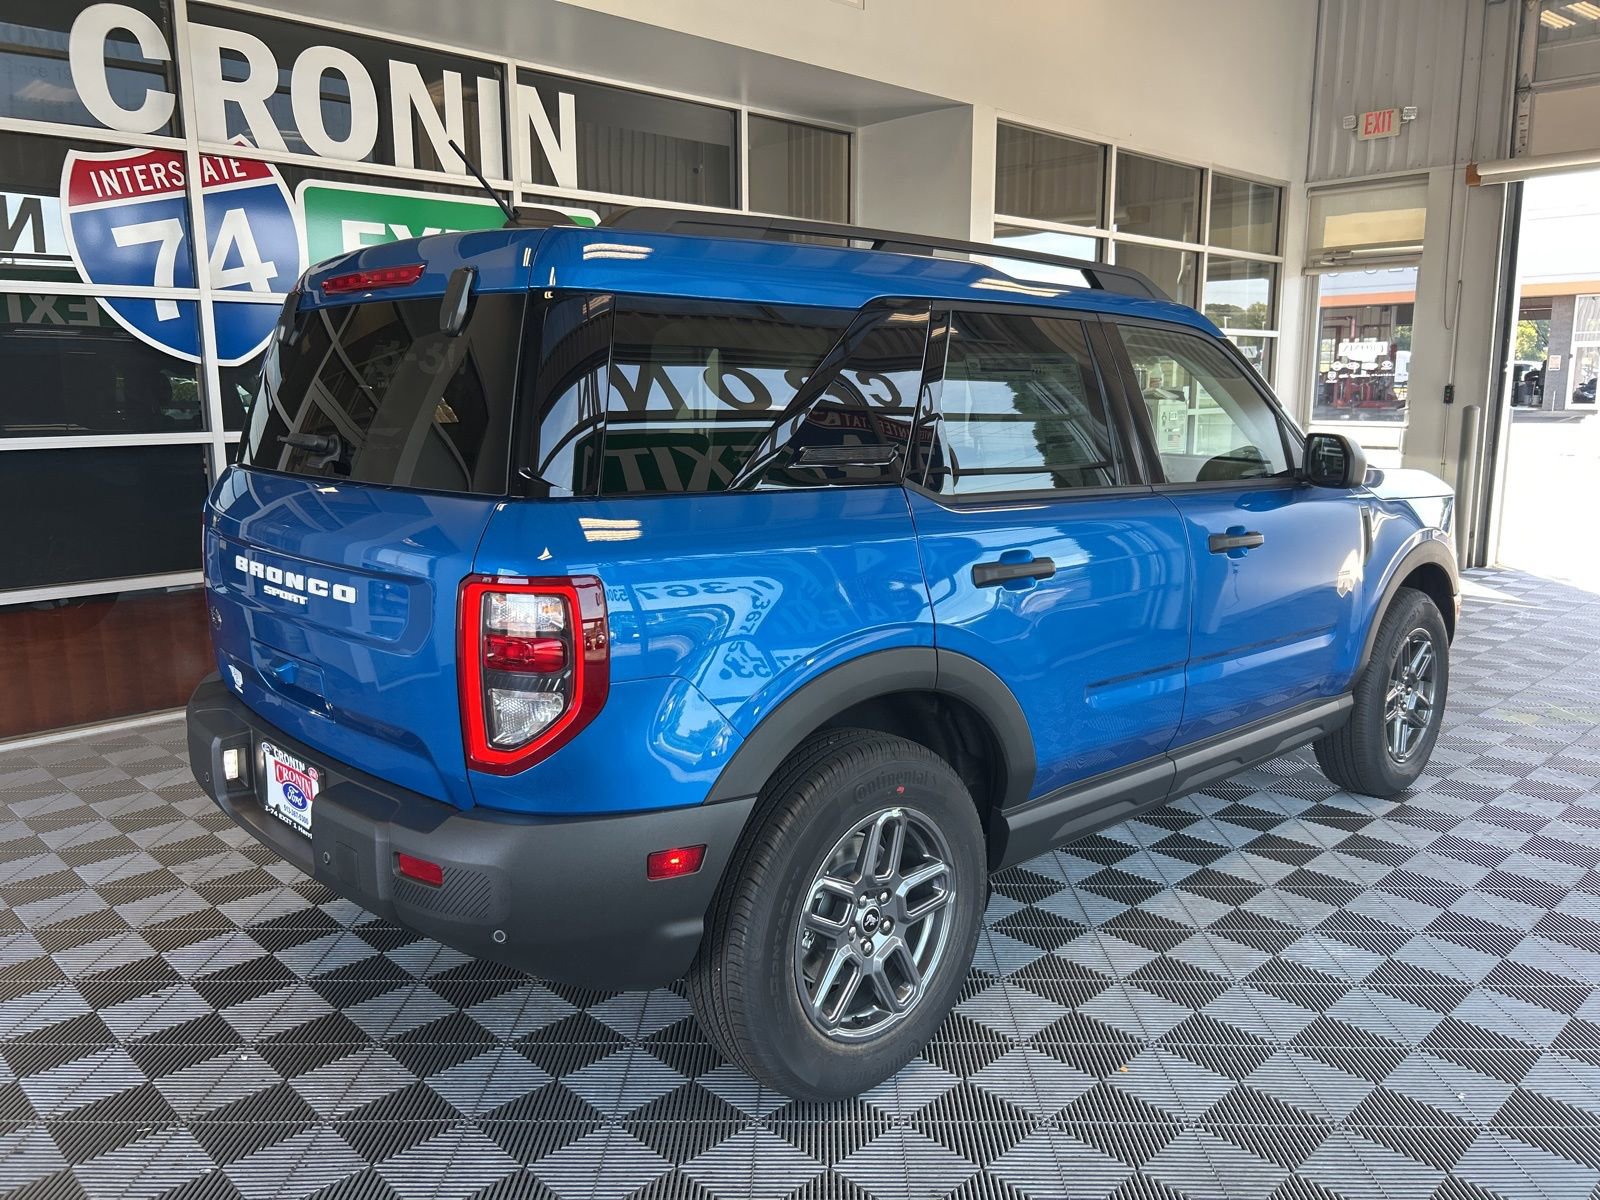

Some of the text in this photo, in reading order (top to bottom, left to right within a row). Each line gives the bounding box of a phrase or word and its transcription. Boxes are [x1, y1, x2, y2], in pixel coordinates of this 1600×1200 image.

[69, 3, 577, 190] CRONIN
[1364, 110, 1394, 136] EXIT
[90, 156, 247, 198] INTERSATE
[111, 208, 278, 322] 74
[235, 555, 357, 604] BRONCO
[263, 584, 308, 605] SPORT
[273, 748, 306, 772] CRONIN
[275, 764, 313, 800] CRONIN
[287, 785, 303, 807] Ford
[278, 813, 293, 826] EXIT
